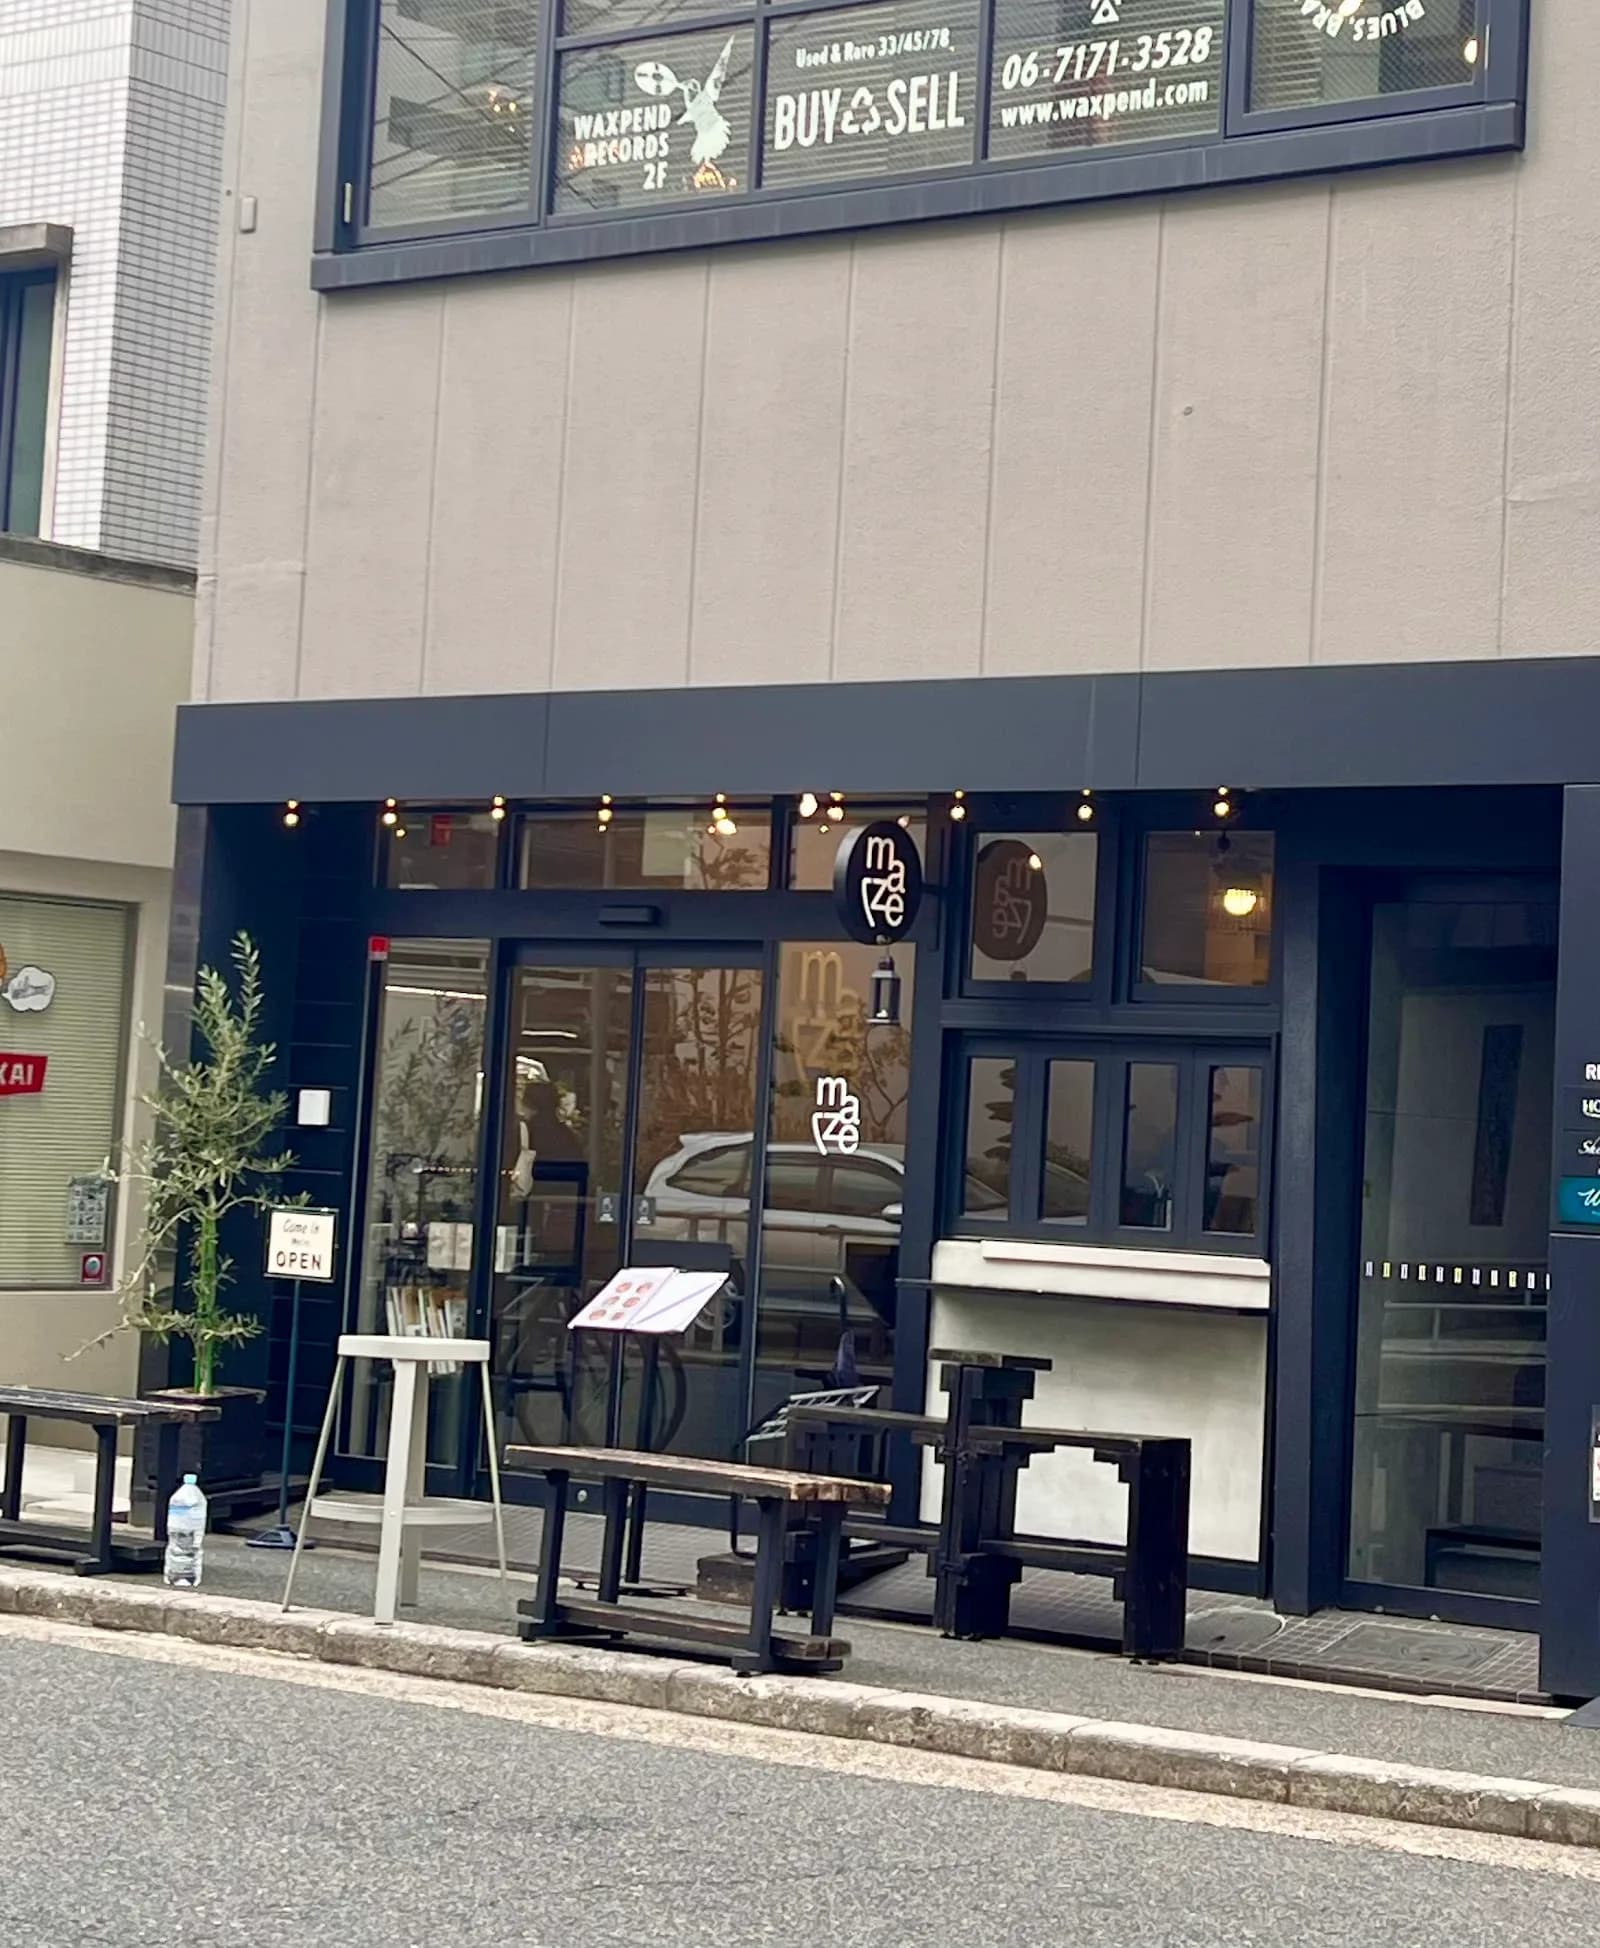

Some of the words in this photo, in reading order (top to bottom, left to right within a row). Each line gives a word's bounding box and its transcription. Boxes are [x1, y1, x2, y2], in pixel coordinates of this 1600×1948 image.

[796, 45, 828, 68] Used
[830, 42, 841, 63] &
[844, 41, 875, 62] Rare
[774, 87, 841, 150] BUY
[885, 71, 965, 135] SELL
[1001, 78, 1208, 127] www.waxpend.com
[574, 104, 671, 140] WAXPEND
[584, 132, 669, 168] RECORDS
[643, 161, 668, 190] 2F
[861, 835, 906, 928] maze
[812, 1076, 860, 1156] maze
[276, 1251, 322, 1270] OPEN
